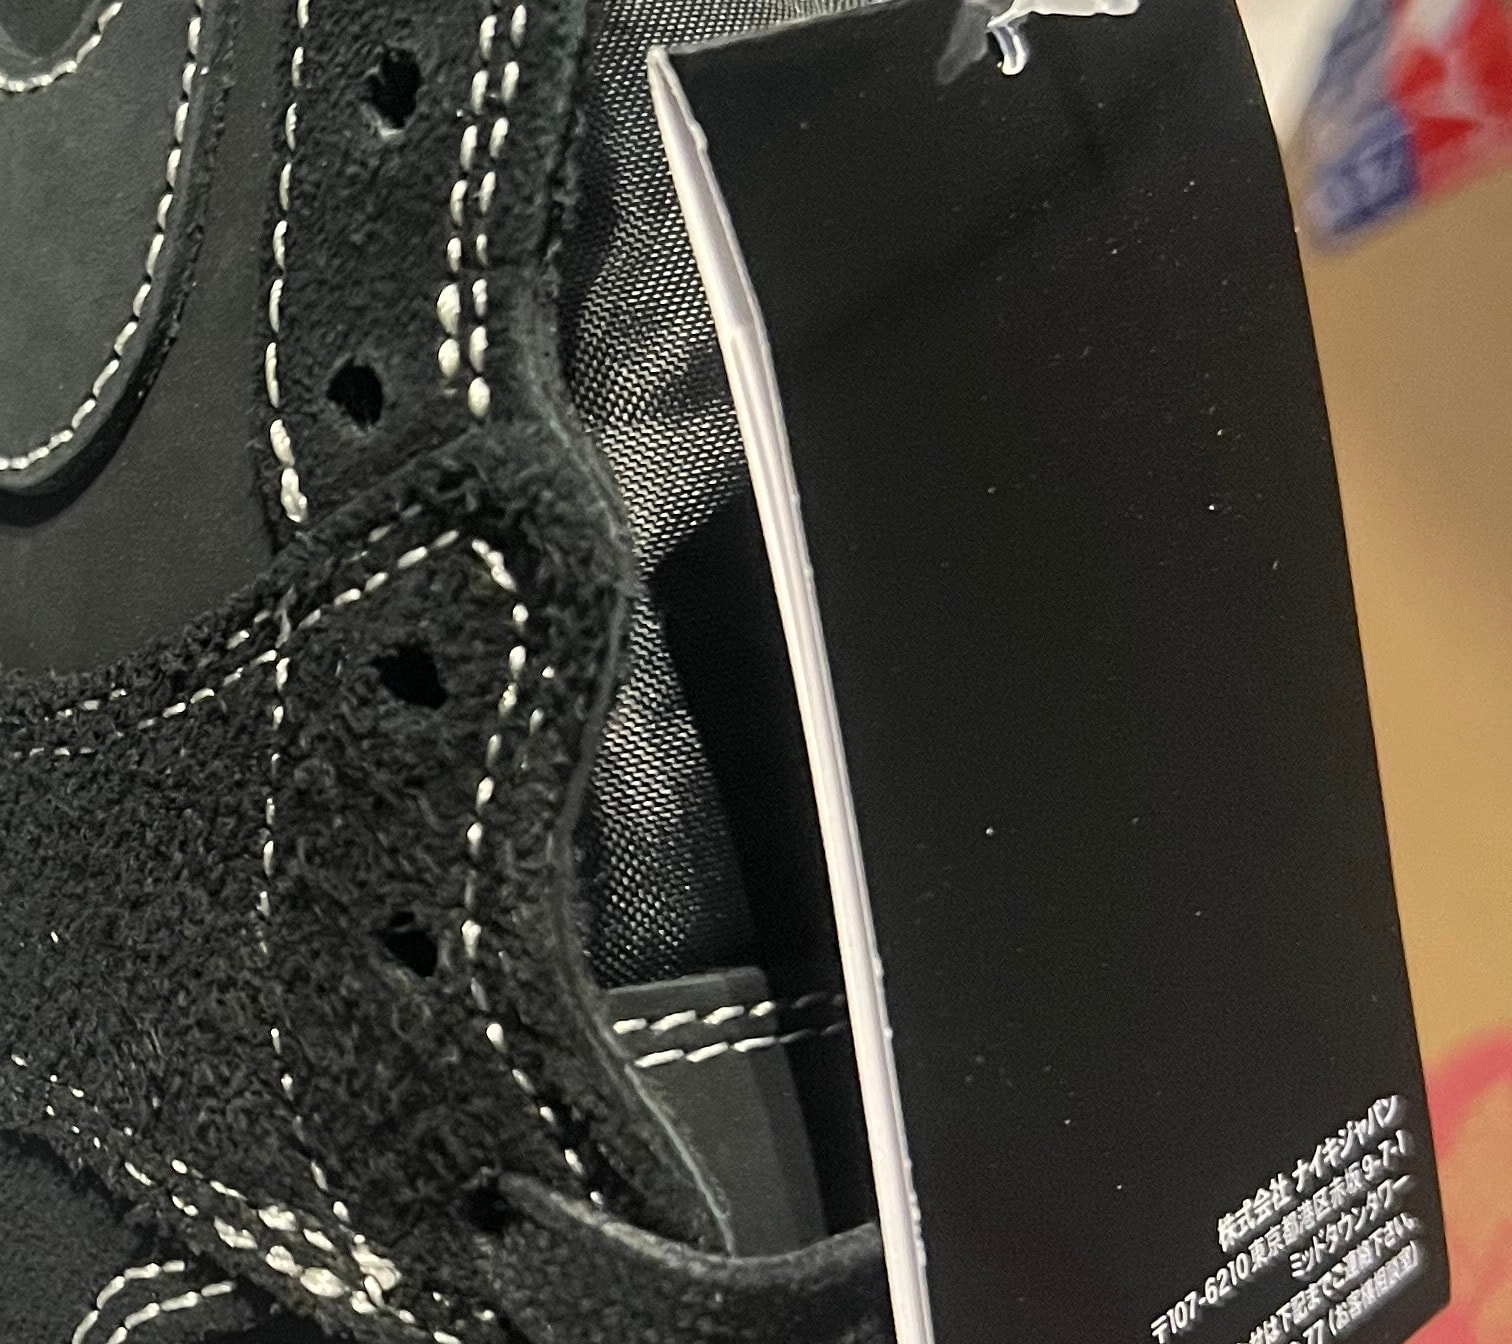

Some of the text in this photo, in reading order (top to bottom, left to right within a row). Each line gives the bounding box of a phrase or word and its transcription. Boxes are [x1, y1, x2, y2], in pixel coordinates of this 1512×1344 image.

[1217, 1095, 1398, 1252] 株式会社 ナイキジャパン
[1289, 1175, 1407, 1278] ミッドタウンタワー
